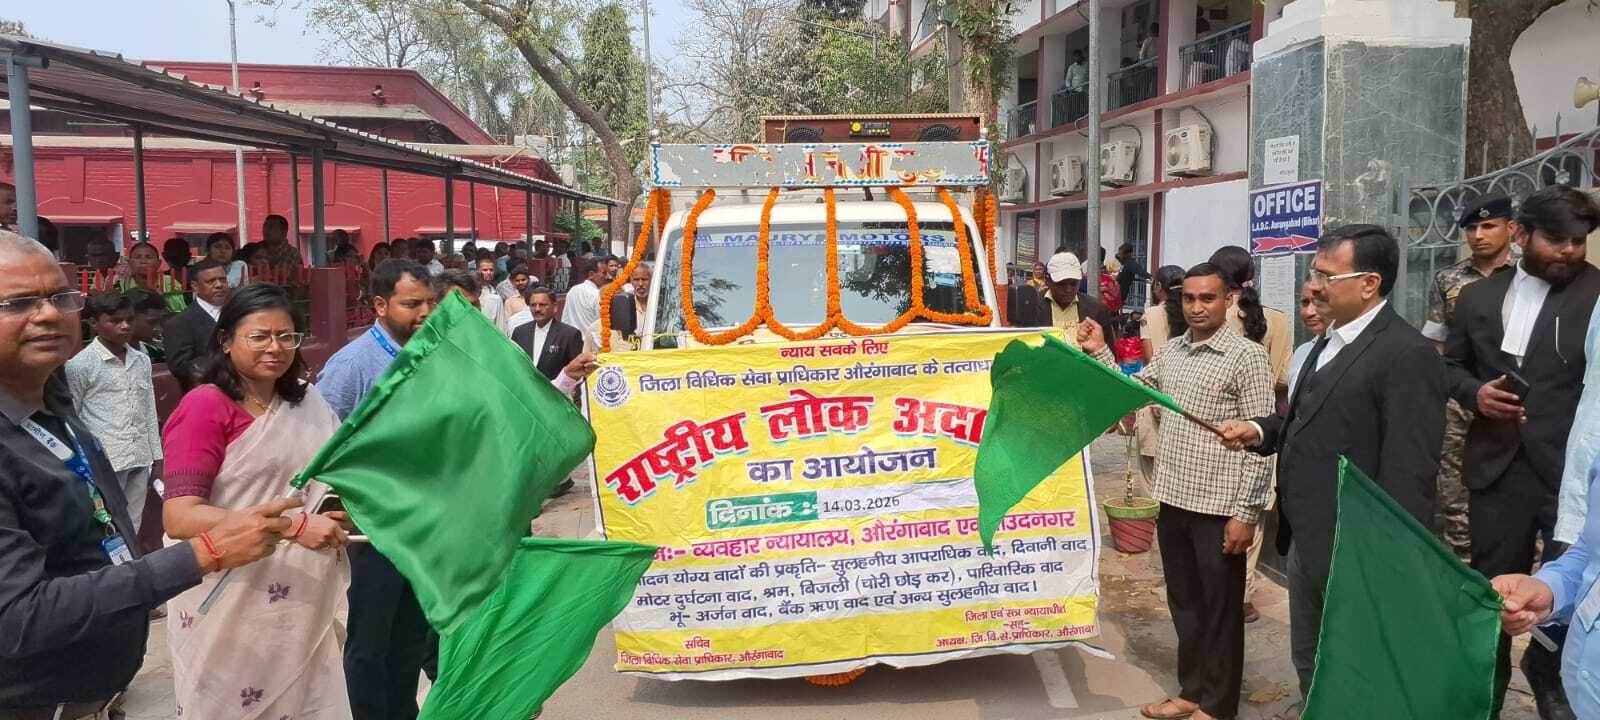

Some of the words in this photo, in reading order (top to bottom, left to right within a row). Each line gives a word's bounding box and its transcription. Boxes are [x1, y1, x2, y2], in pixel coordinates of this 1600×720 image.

[1254, 186, 1316, 218] OFFICE
[1271, 217, 1301, 230] Aurangabad
[781, 346, 814, 359] न्याय
[862, 339, 889, 355] लिए
[640, 374, 681, 392] जिला
[687, 370, 736, 389] विधिक
[742, 368, 772, 386] सेवा
[776, 365, 840, 385] प्राधिकार
[844, 362, 918, 380] औरंगाबाद
[923, 358, 939, 375] के
[605, 412, 749, 502] राष्ट्रीय
[759, 389, 874, 440] लोक
[747, 459, 794, 482] का
[802, 447, 937, 479] आयोजन
[710, 497, 794, 525] दिनांक
[823, 497, 900, 513] 14.03.2026
[691, 537, 761, 558] व्यवहार
[766, 529, 855, 551] न्यायालय,
[862, 518, 951, 544] औरंगाबाद
[672, 569, 709, 584] योग्य
[714, 565, 746, 582] वादों
[750, 562, 770, 578] की
[831, 550, 897, 577] सुलहनीय
[901, 545, 972, 564] आपराधिक
[1011, 536, 1057, 554] दिवानी
[1060, 538, 1088, 551] वाद
[637, 592, 671, 607] मोटर
[675, 589, 725, 611] दुर्घटना
[727, 589, 758, 603] वाद,
[763, 585, 795, 599] श्रम,
[800, 576, 850, 596] बिजली
[856, 571, 891, 595] (चोरी
[895, 572, 921, 589] छोड़
[967, 562, 1036, 580] पारिवारिक
[1040, 561, 1064, 574] वाद
[696, 605, 737, 622] अर्जन
[741, 605, 773, 619] वाद,
[778, 599, 805, 615] बैंक
[809, 599, 839, 612] ऋण
[842, 596, 869, 609] वाद
[874, 590, 898, 607] एवं
[899, 590, 932, 605] अन्य
[938, 582, 999, 606] सुलहनीय
[965, 610, 988, 622] जिला
[685, 636, 711, 649] सचिव
